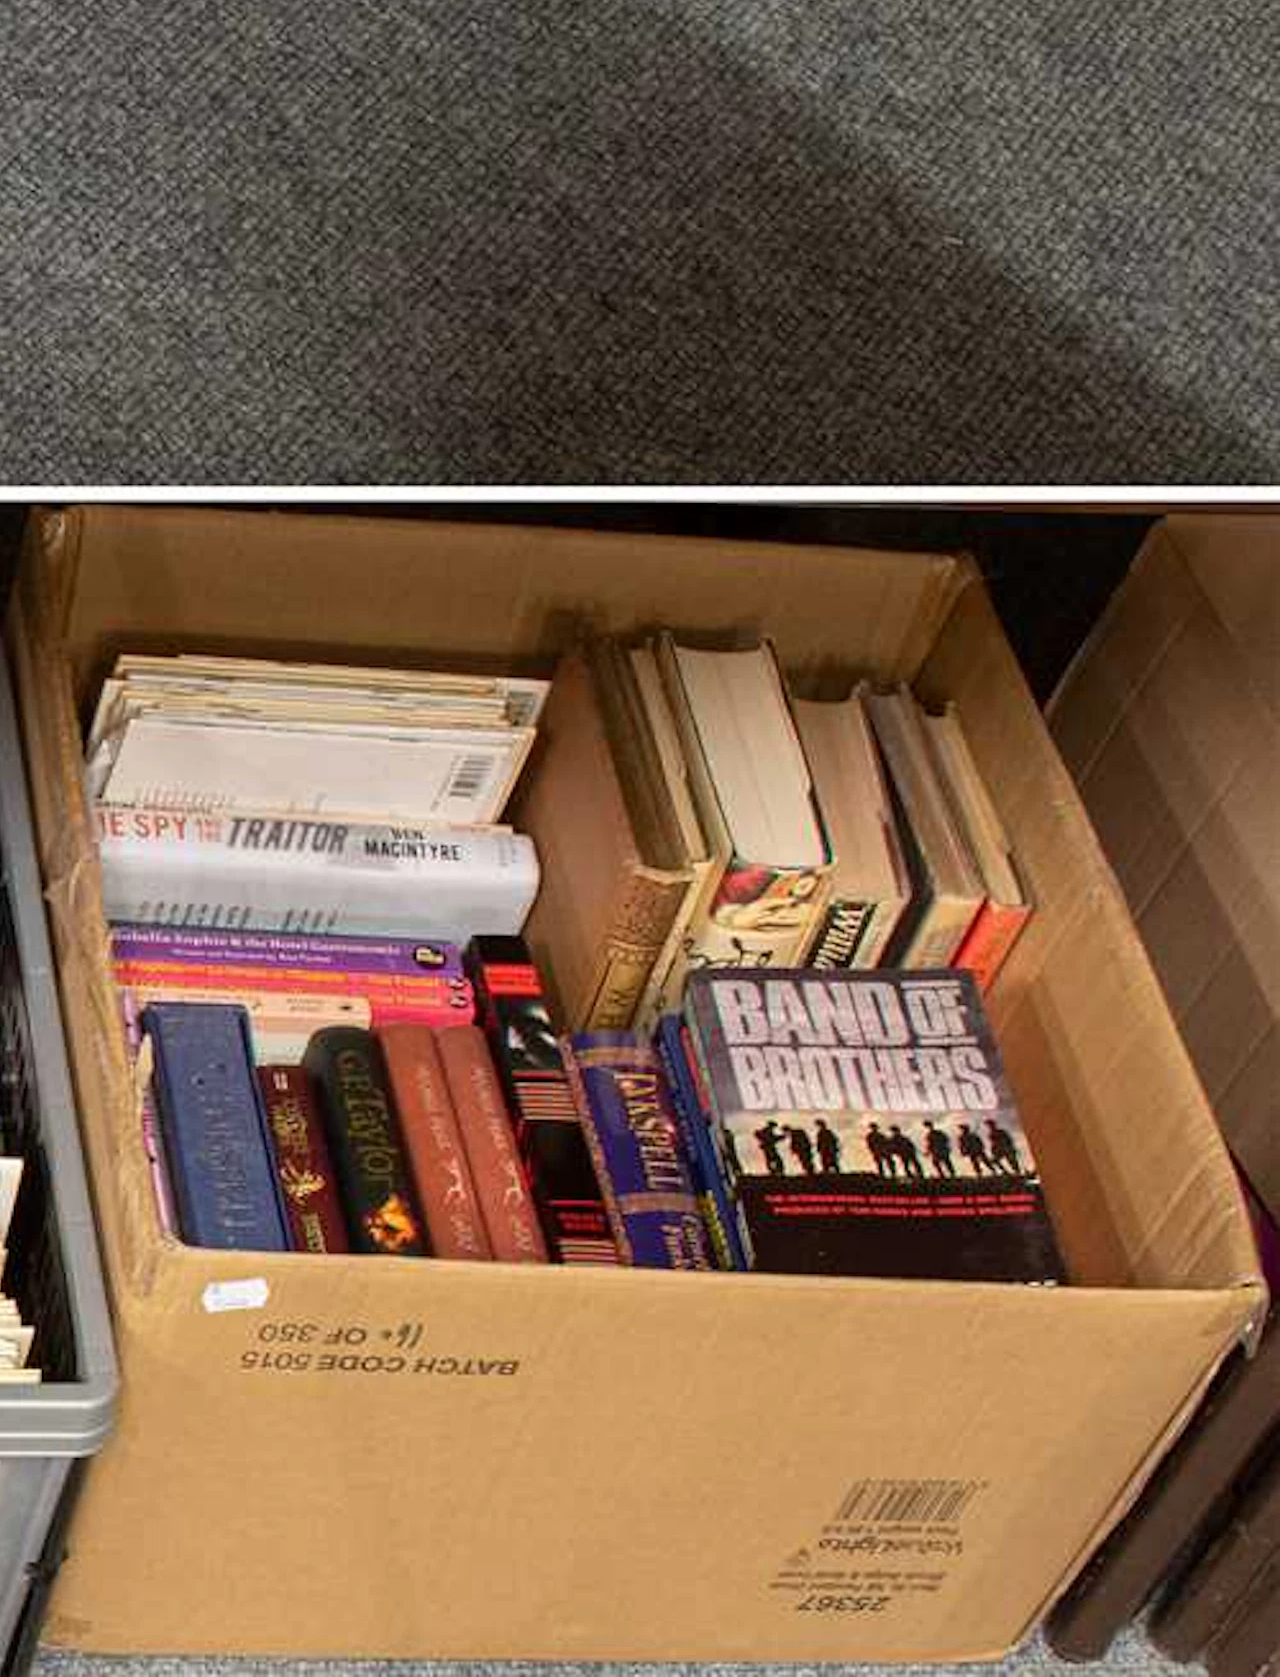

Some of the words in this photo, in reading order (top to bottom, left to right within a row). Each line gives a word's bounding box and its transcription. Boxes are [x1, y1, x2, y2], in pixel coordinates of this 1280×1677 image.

[138, 816, 188, 842] SPY
[227, 816, 350, 855] TRAITOR
[363, 839, 464, 863] MACINTYRE
[712, 978, 914, 1047] BAND
[904, 983, 975, 1037] OF
[731, 1046, 1000, 1112] BROTHERS
[258, 1323, 320, 1345] 350
[324, 1325, 368, 1345] OF
[240, 1349, 316, 1373] 5015
[317, 1352, 408, 1375] CODE
[412, 1355, 519, 1378] BATCH
[796, 1593, 891, 1615] 25367
